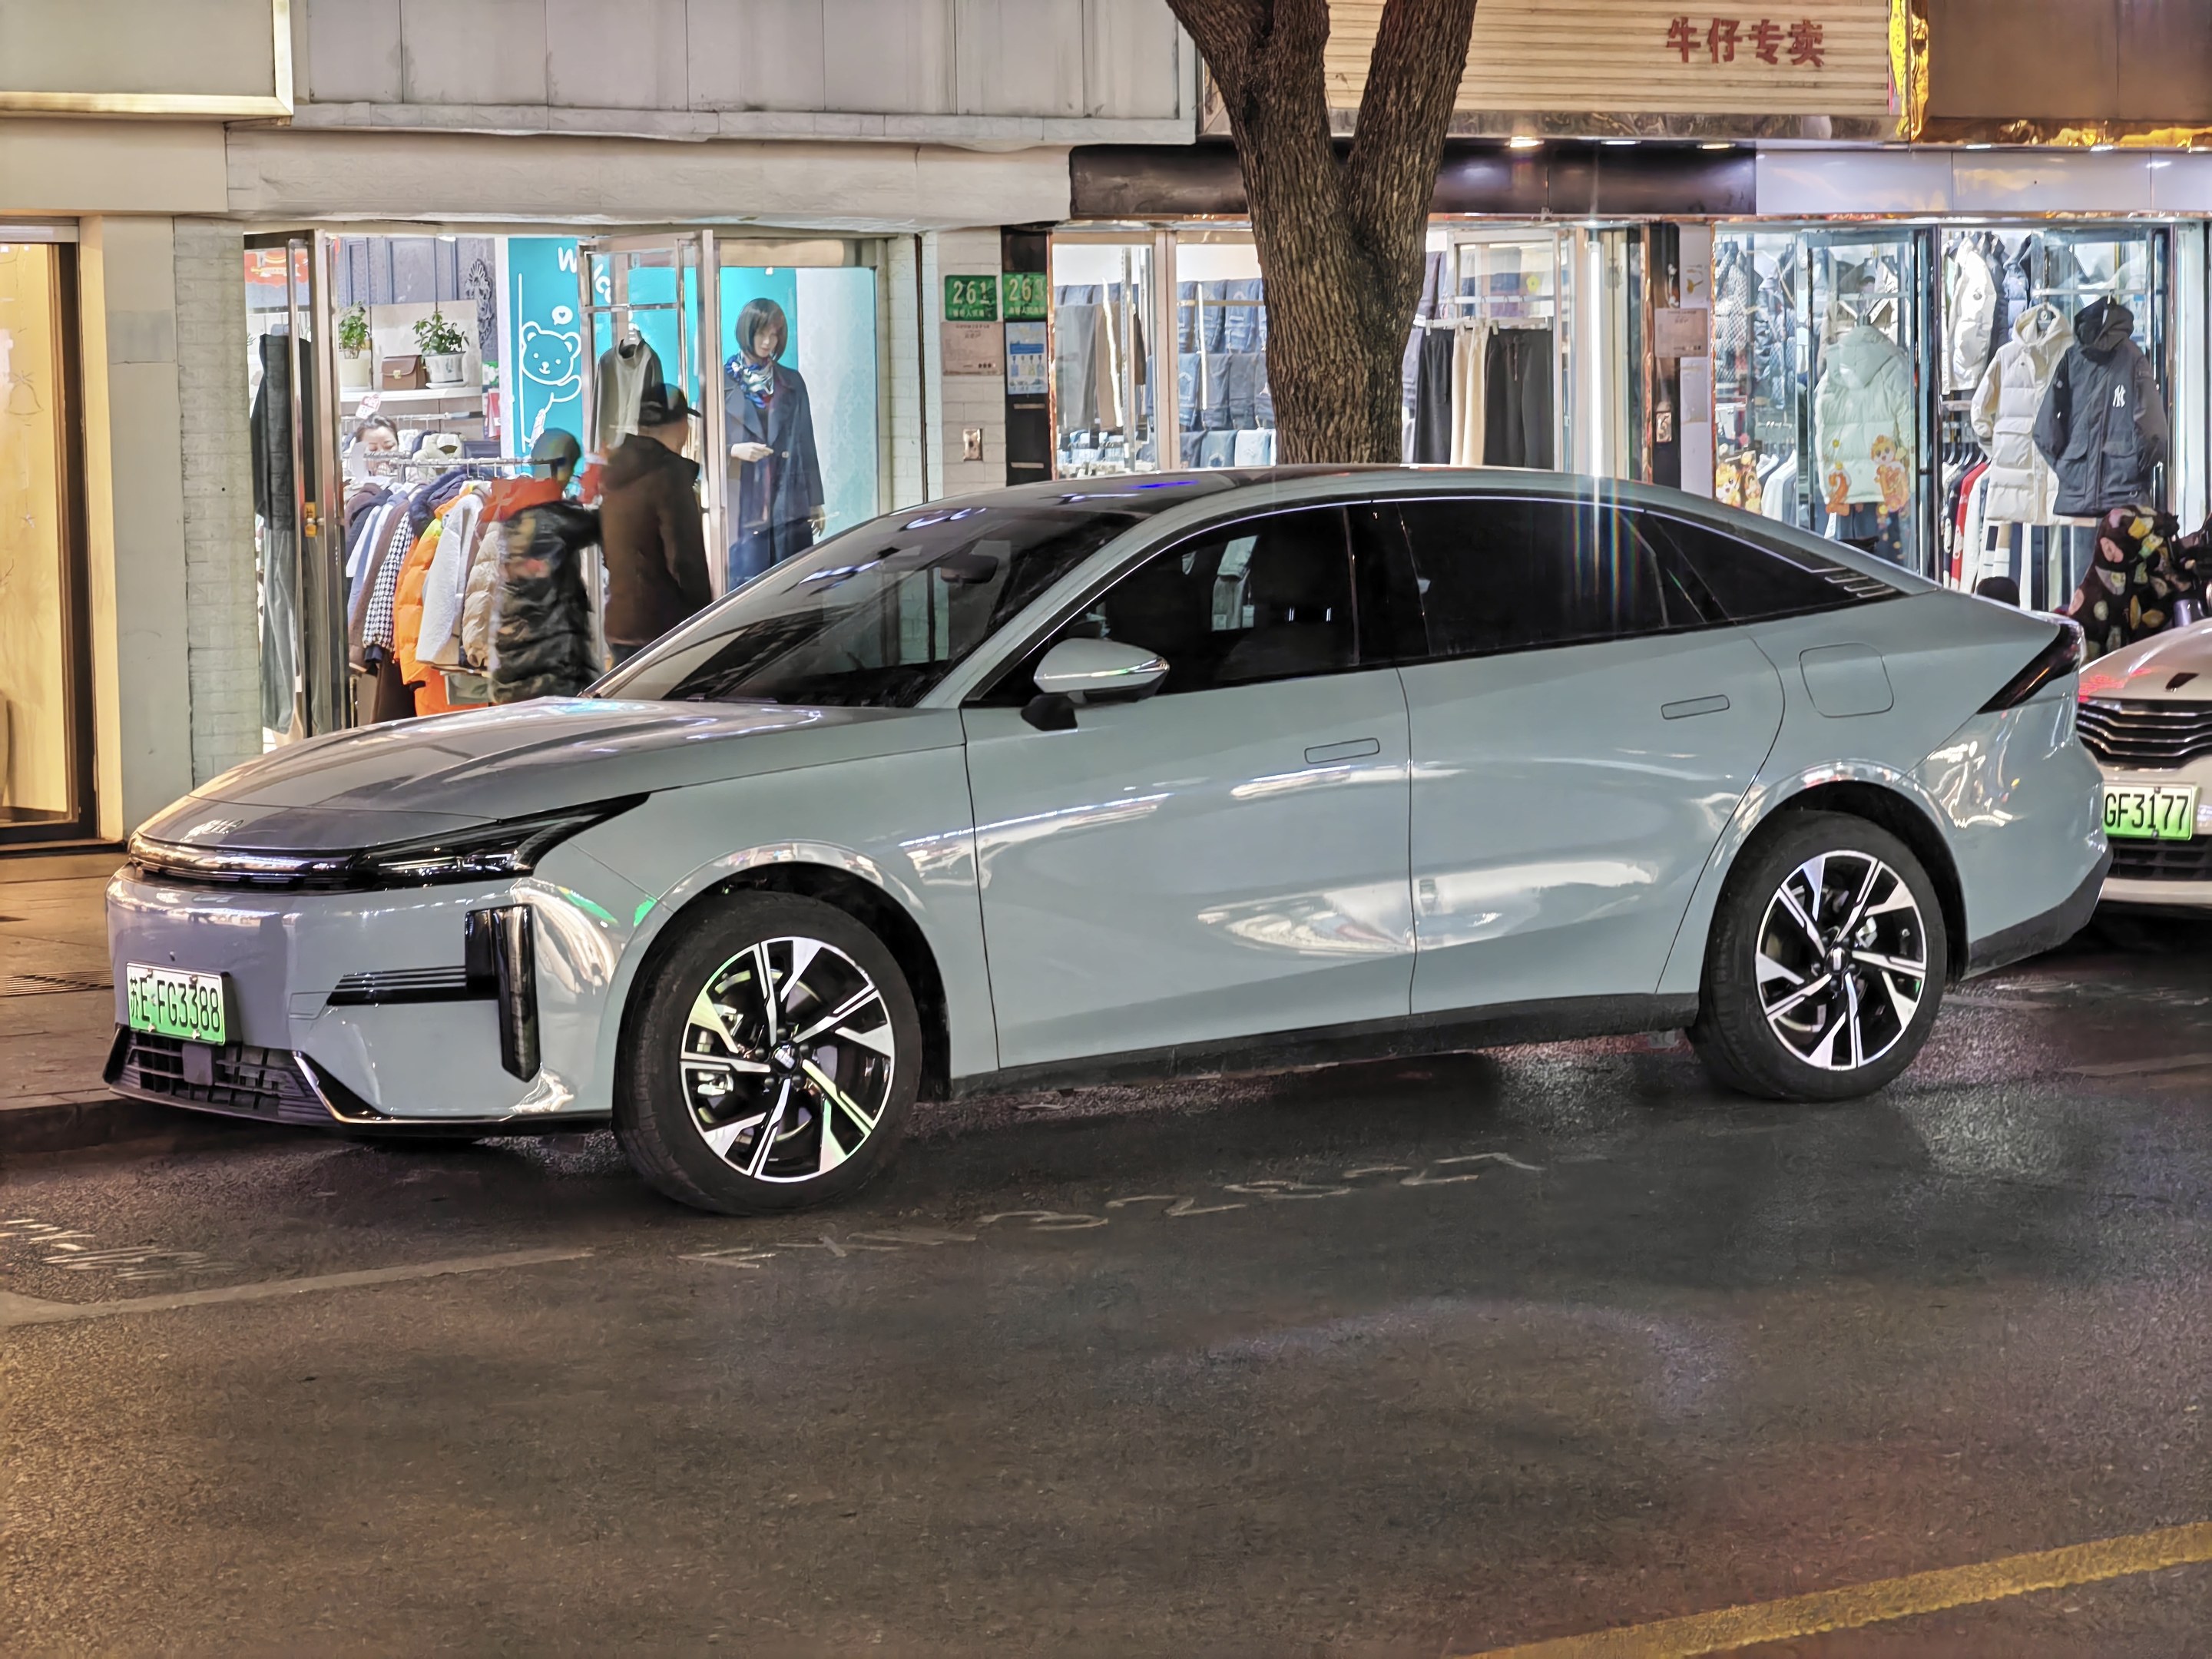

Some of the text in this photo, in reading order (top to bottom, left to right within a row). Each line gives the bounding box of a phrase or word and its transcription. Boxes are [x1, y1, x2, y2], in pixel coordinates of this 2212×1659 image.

[1665, 16, 1826, 68] 牛仔专卖
[952, 280, 990, 305] 261
[2104, 792, 2189, 830] GF3177
[157, 979, 221, 1032] FG3388
